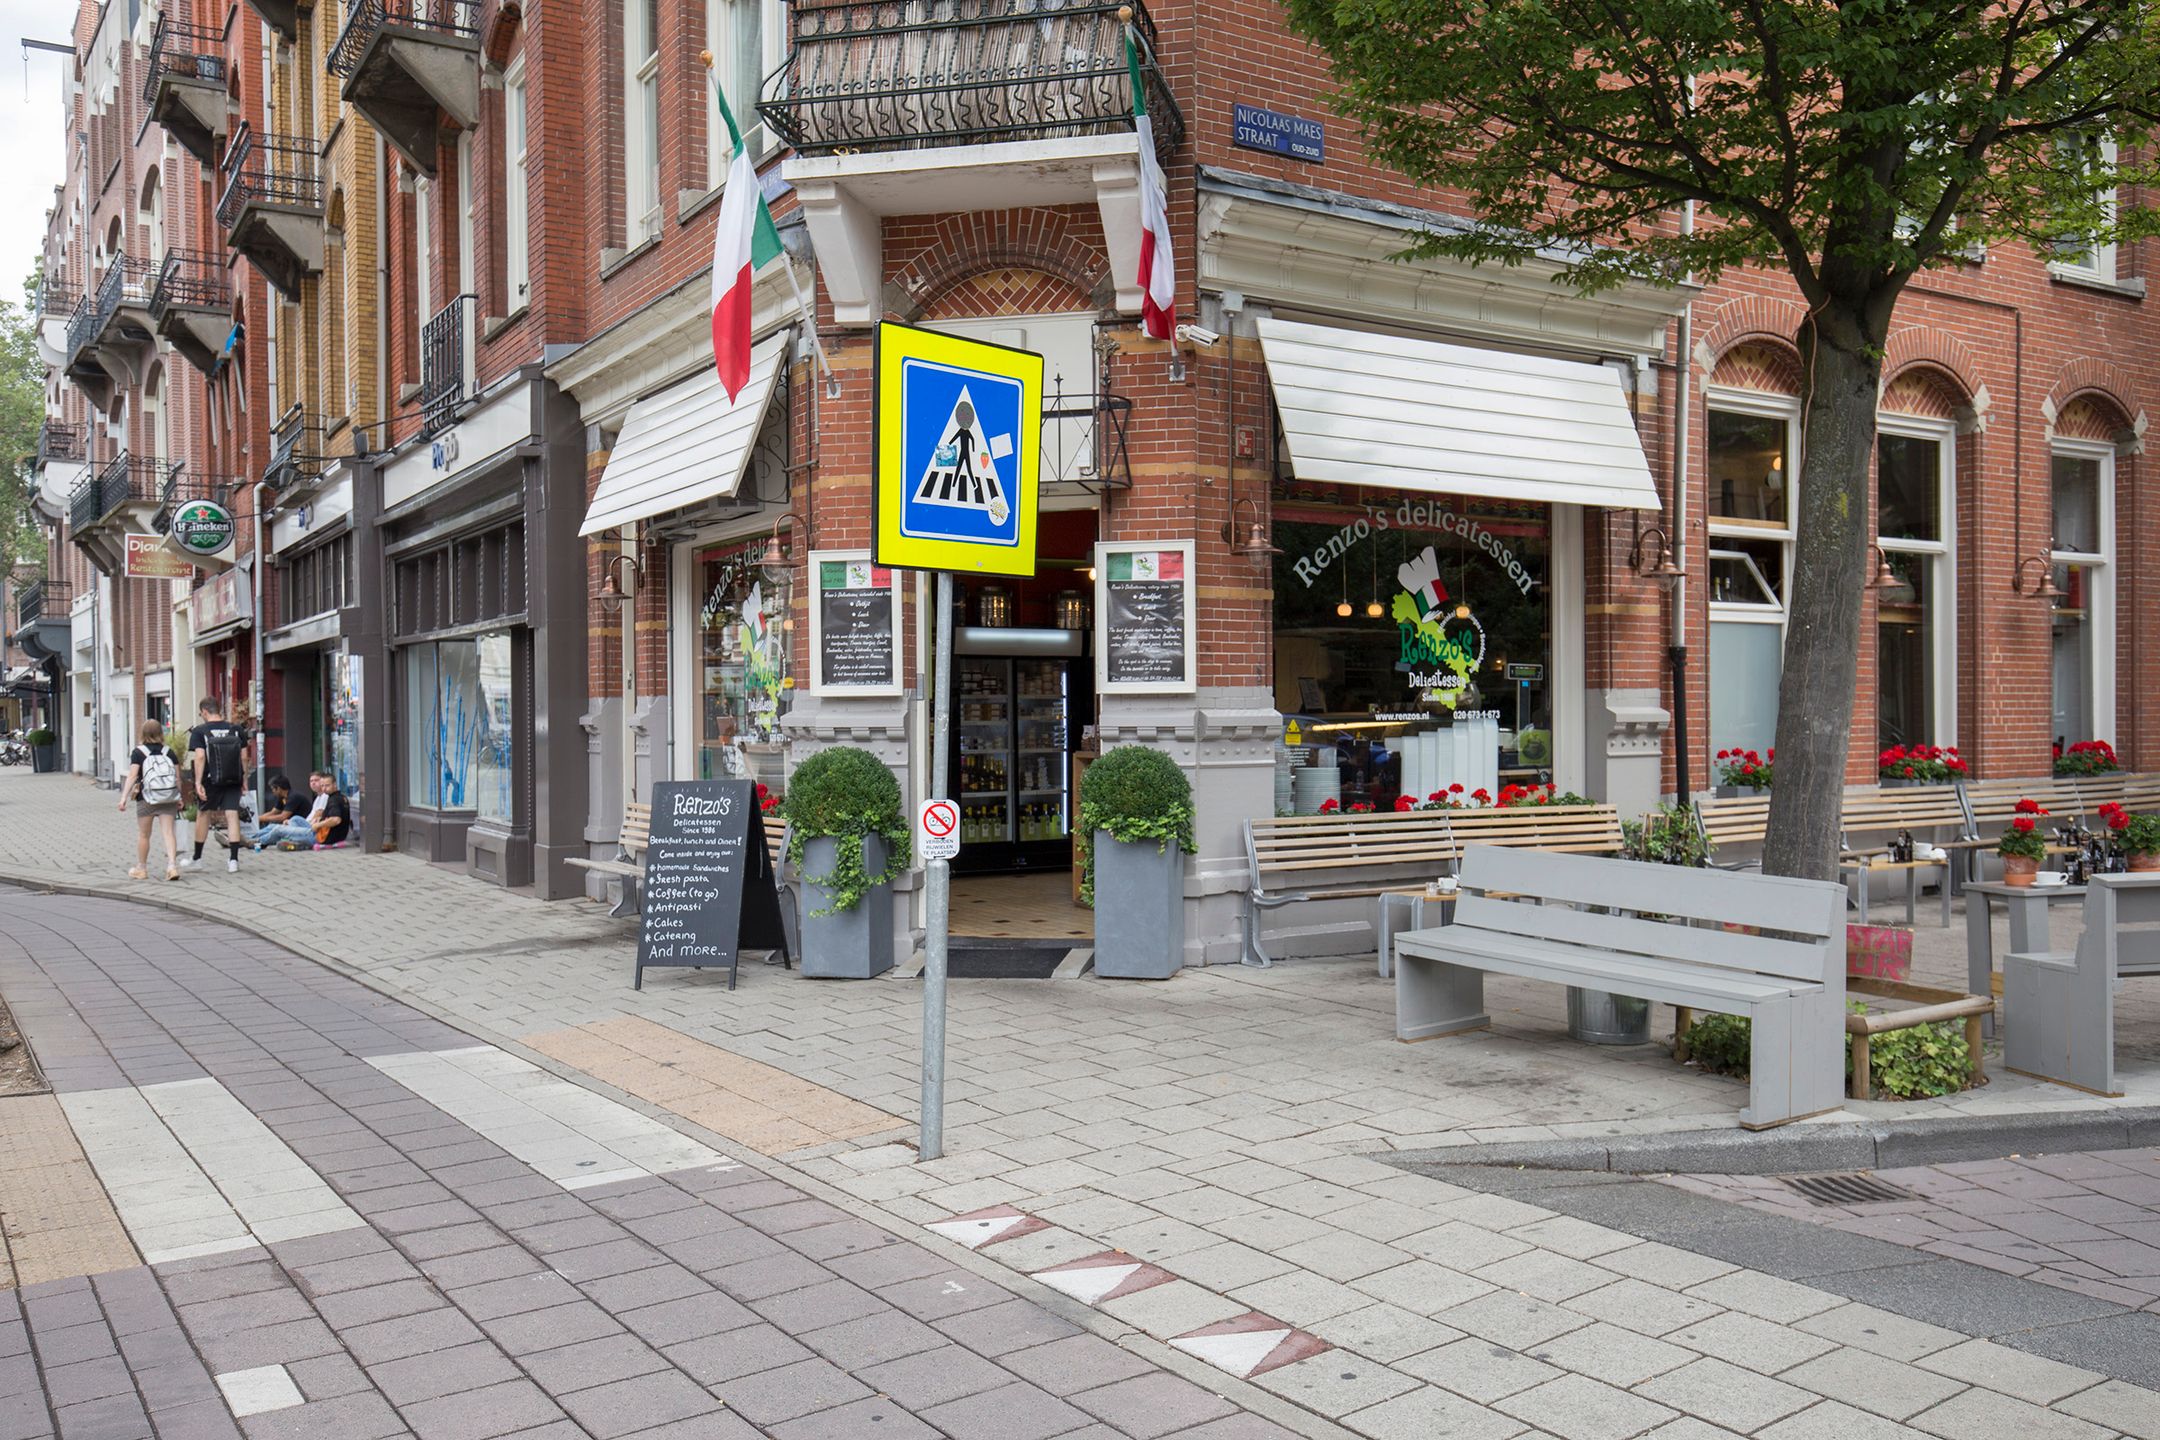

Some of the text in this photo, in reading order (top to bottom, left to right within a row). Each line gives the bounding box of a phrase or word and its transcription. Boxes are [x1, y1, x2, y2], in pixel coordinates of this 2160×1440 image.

[1238, 108, 1322, 140] NICOLAAS MAES
[1238, 126, 1278, 147] STRAAT
[1291, 143, 1320, 157] OUD-ZUID
[1293, 499, 1534, 596] Renzo's delicatessen
[1399, 623, 1473, 666] Renzo's
[1408, 669, 1467, 688] Delicatessen
[1375, 711, 1430, 721] www.renzos.nl
[673, 818, 722, 827] Delicatessen
[684, 836, 704, 844] lunch
[659, 849, 675, 859] Come
[676, 850, 693, 858] inside
[706, 850, 720, 858] enjoy
[657, 863, 690, 871] homemade
[683, 875, 710, 888] pasta
[655, 887, 719, 902] Coffee (to go)
[654, 903, 702, 913] Antipasti
[654, 917, 684, 928] Cakes
[648, 944, 674, 959] And
